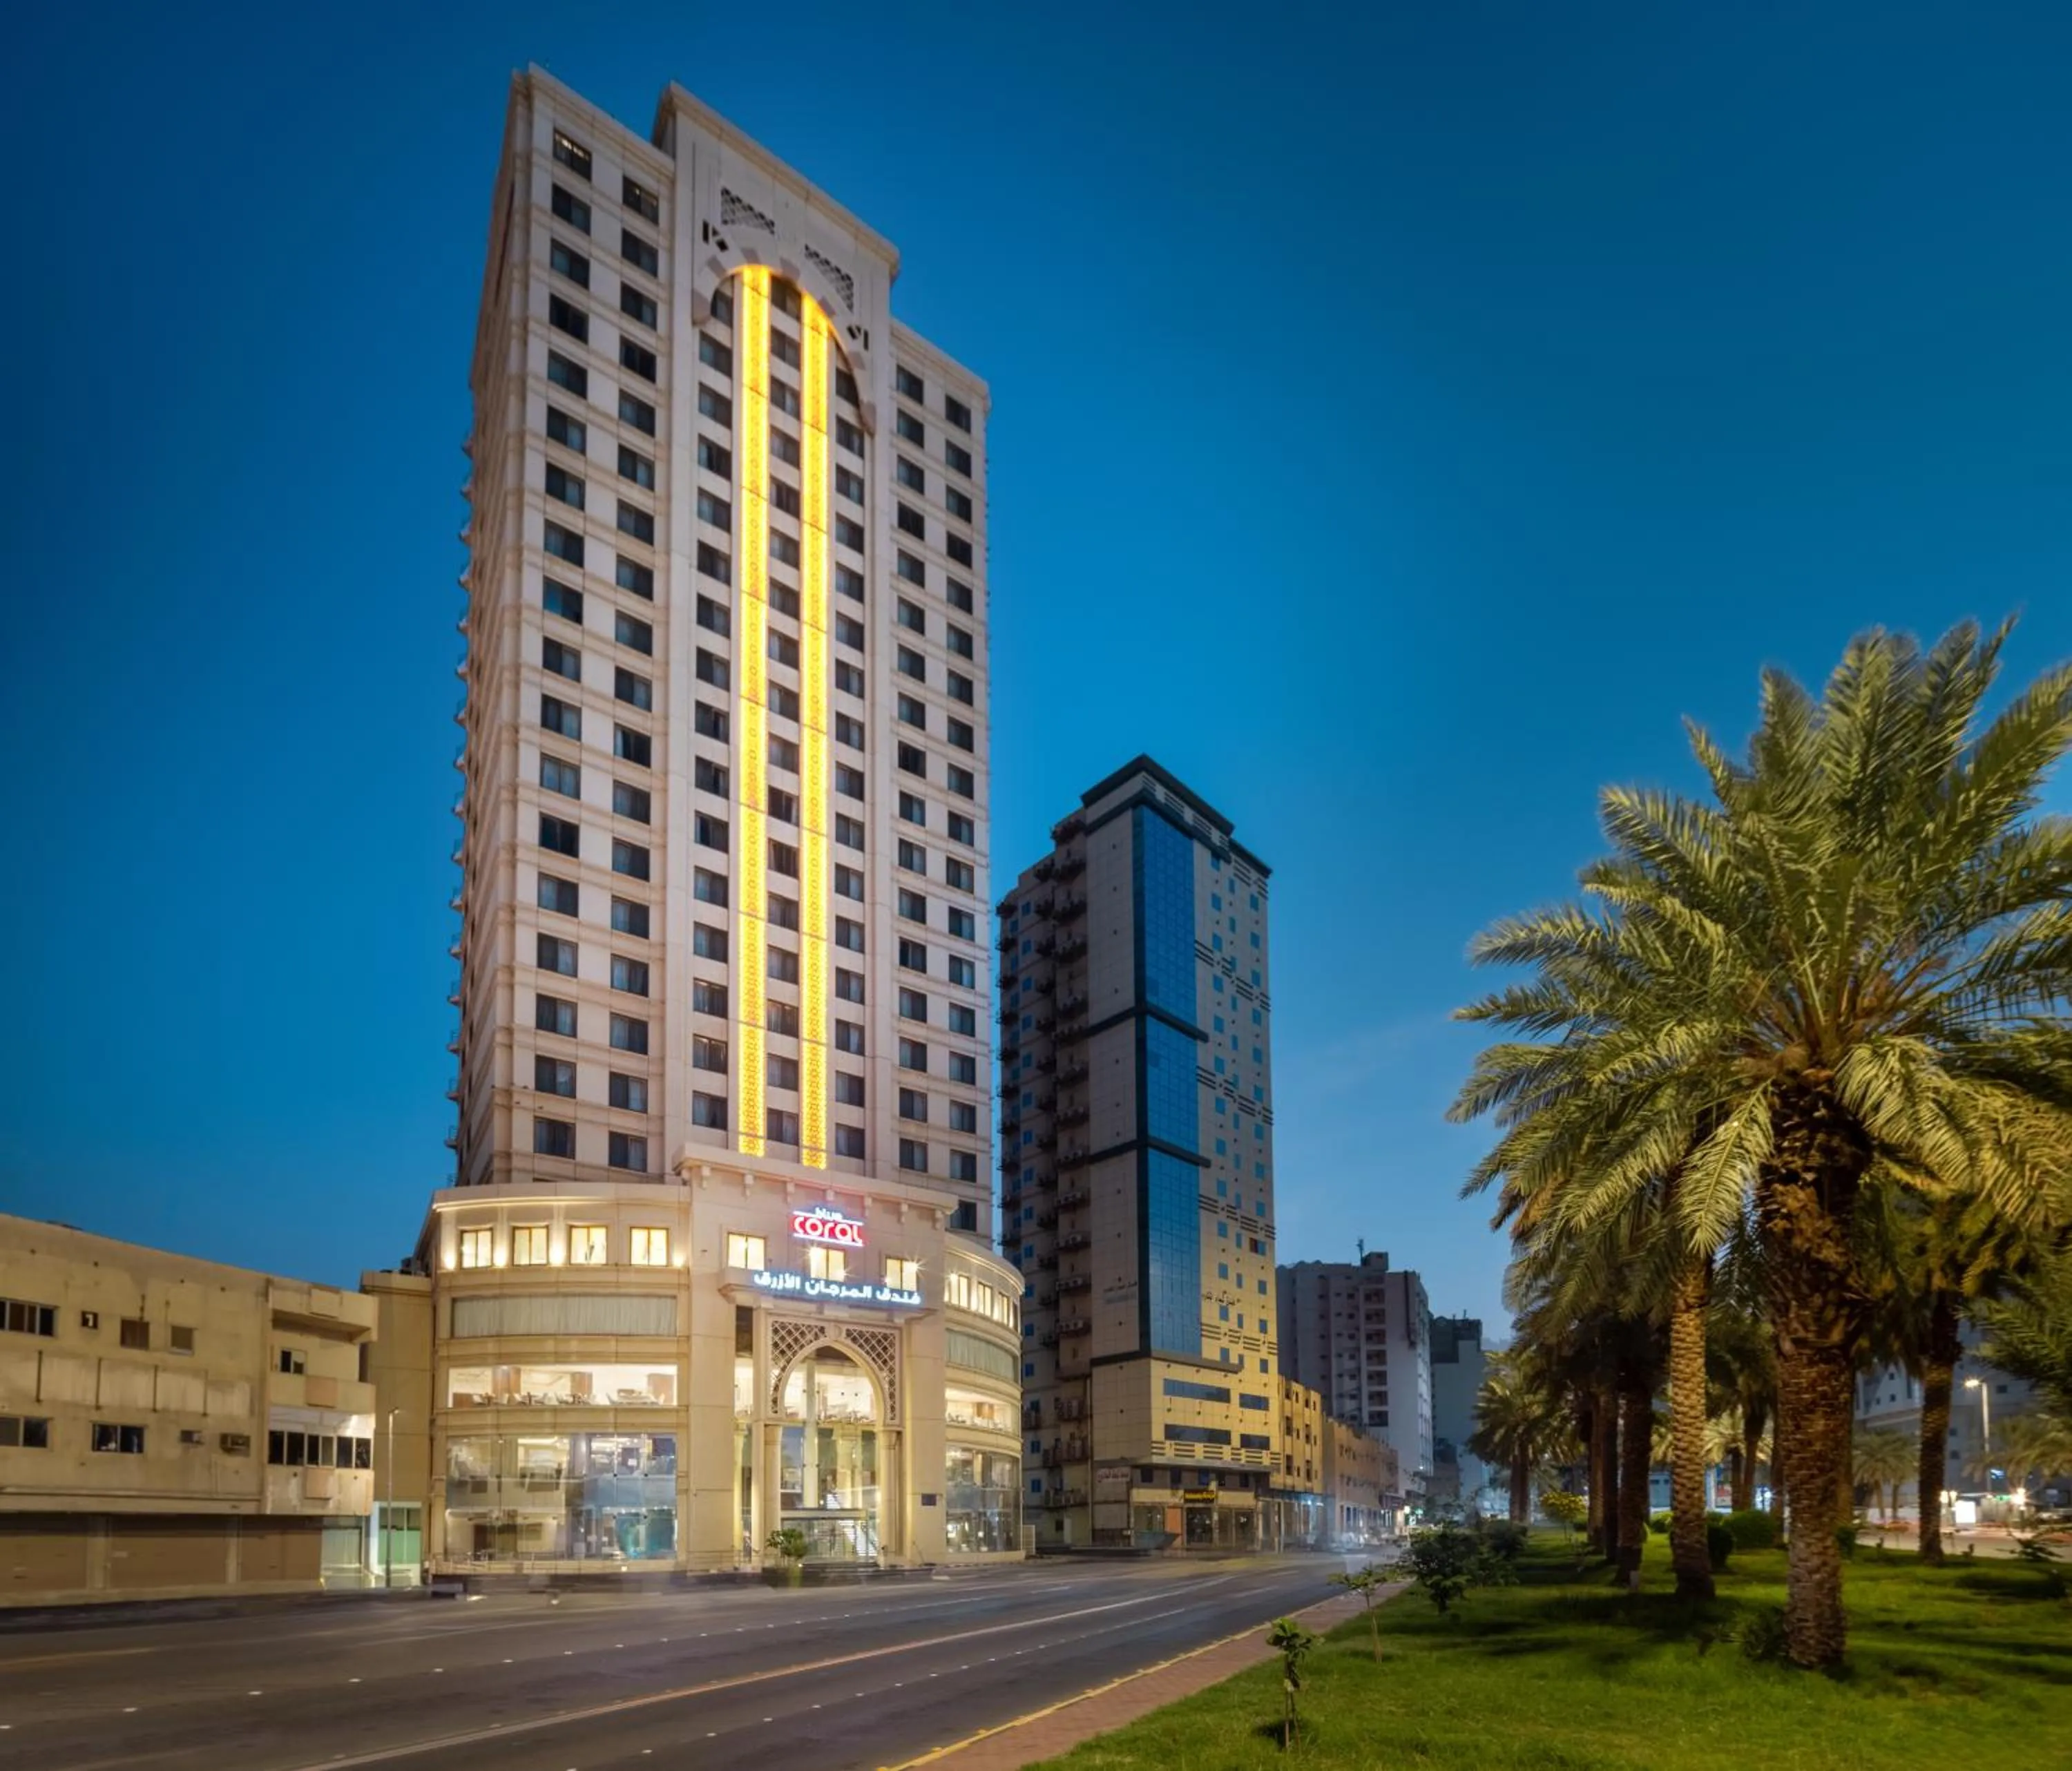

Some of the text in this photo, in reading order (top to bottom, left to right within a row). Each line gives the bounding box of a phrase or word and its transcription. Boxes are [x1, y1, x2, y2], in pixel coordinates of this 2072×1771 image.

[794, 1216, 863, 1244] coral
[805, 1279, 872, 1299] المرجان
[875, 1287, 921, 1305] فندق
